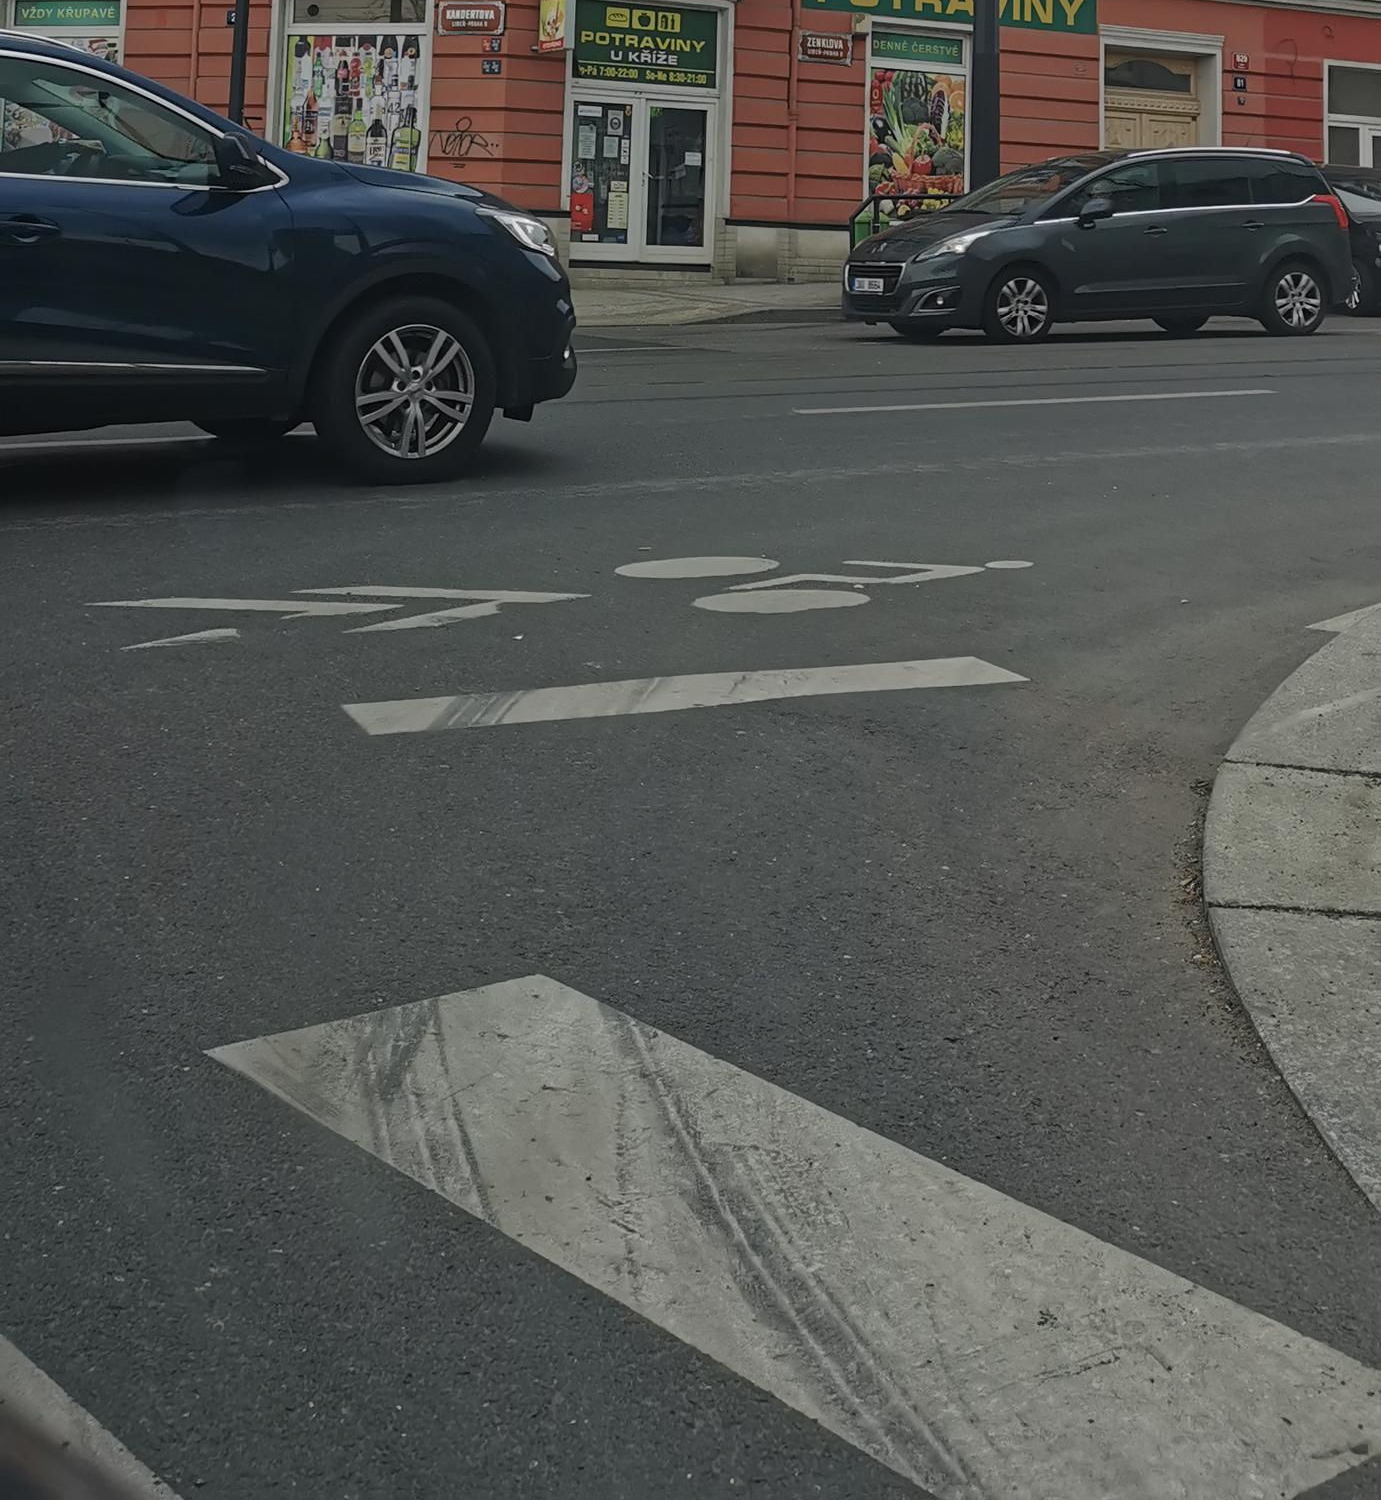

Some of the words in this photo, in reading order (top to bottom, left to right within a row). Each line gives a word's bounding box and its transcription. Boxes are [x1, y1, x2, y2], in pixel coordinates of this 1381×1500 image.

[21, 7, 54, 19] VŽDY
[57, 5, 116, 19] KŘUPAVÉ
[446, 9, 495, 20] KANDERTOVA
[580, 31, 706, 53] POTRAVINY
[807, 36, 844, 50] ZENKLOVA
[873, 39, 908, 51] DENNĚ
[911, 41, 959, 57] ČERSTVÉ
[610, 50, 622, 61] U
[628, 49, 678, 66] KŘÍŽE
